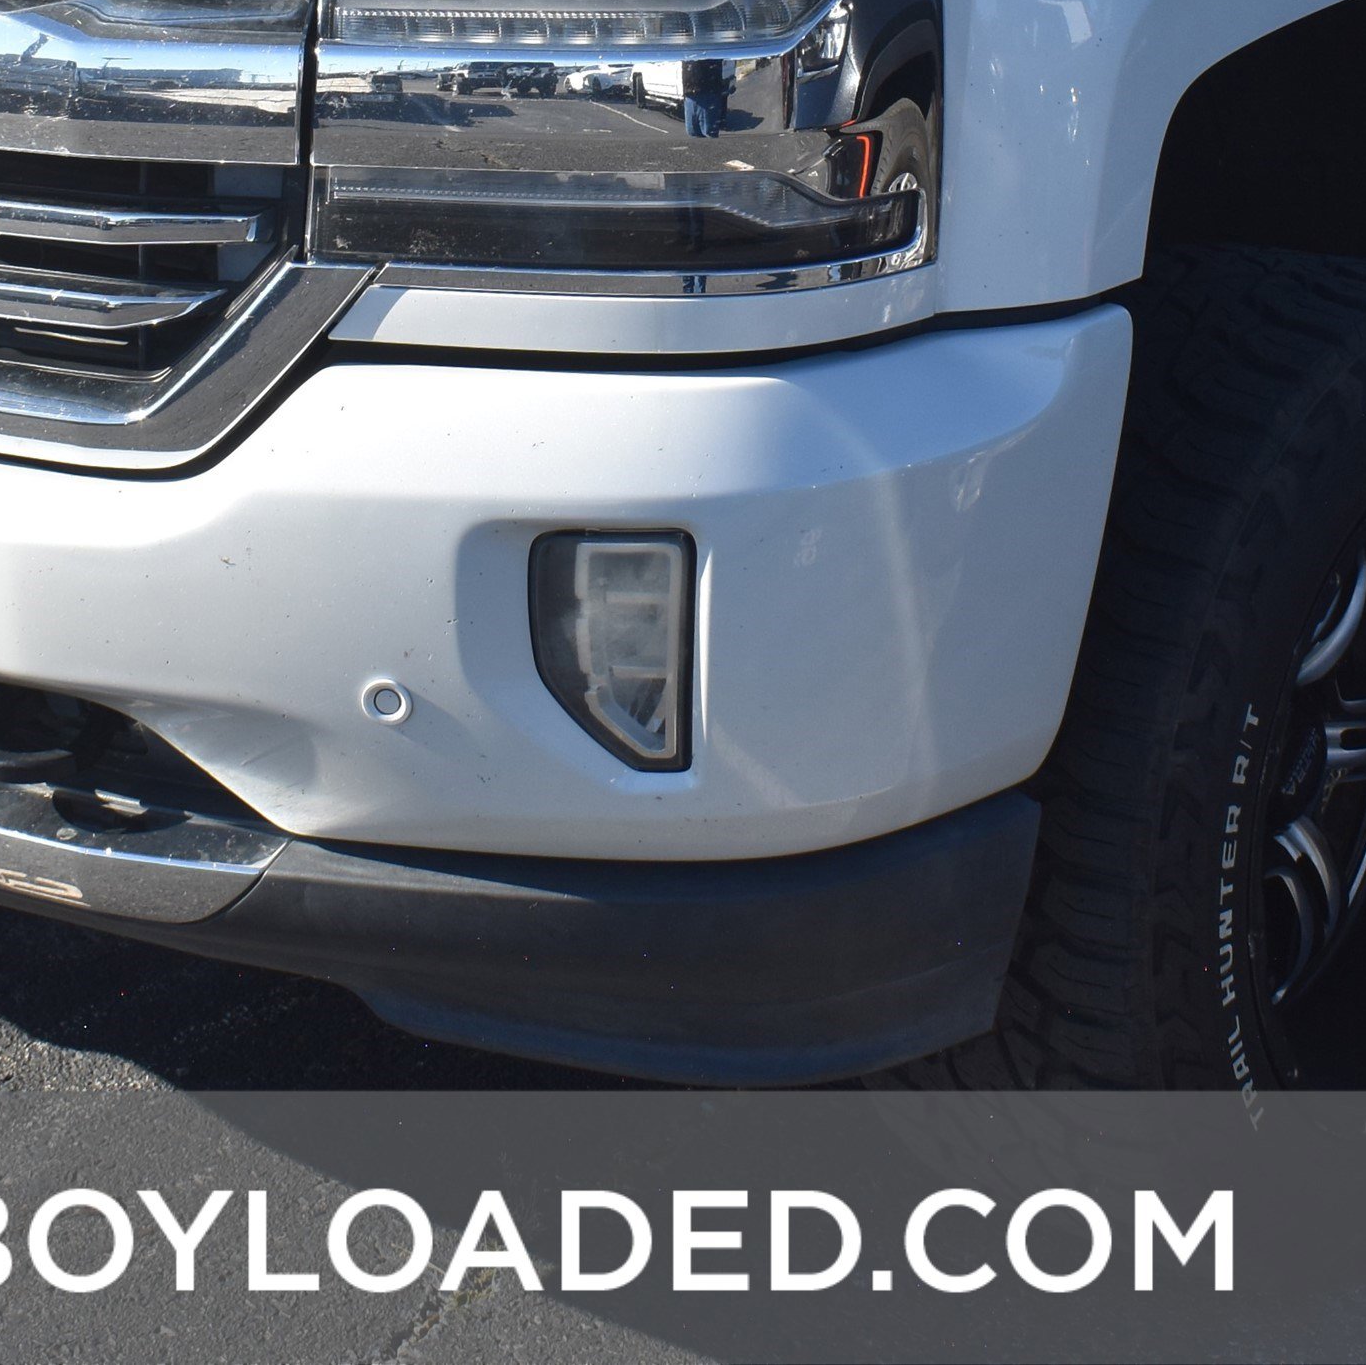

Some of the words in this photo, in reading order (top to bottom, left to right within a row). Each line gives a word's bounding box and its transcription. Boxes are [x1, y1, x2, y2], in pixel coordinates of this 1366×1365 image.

[1231, 703, 1261, 785] R/T
[1218, 804, 1242, 1007] HUNTER
[1228, 1015, 1265, 1132] TRAIL
